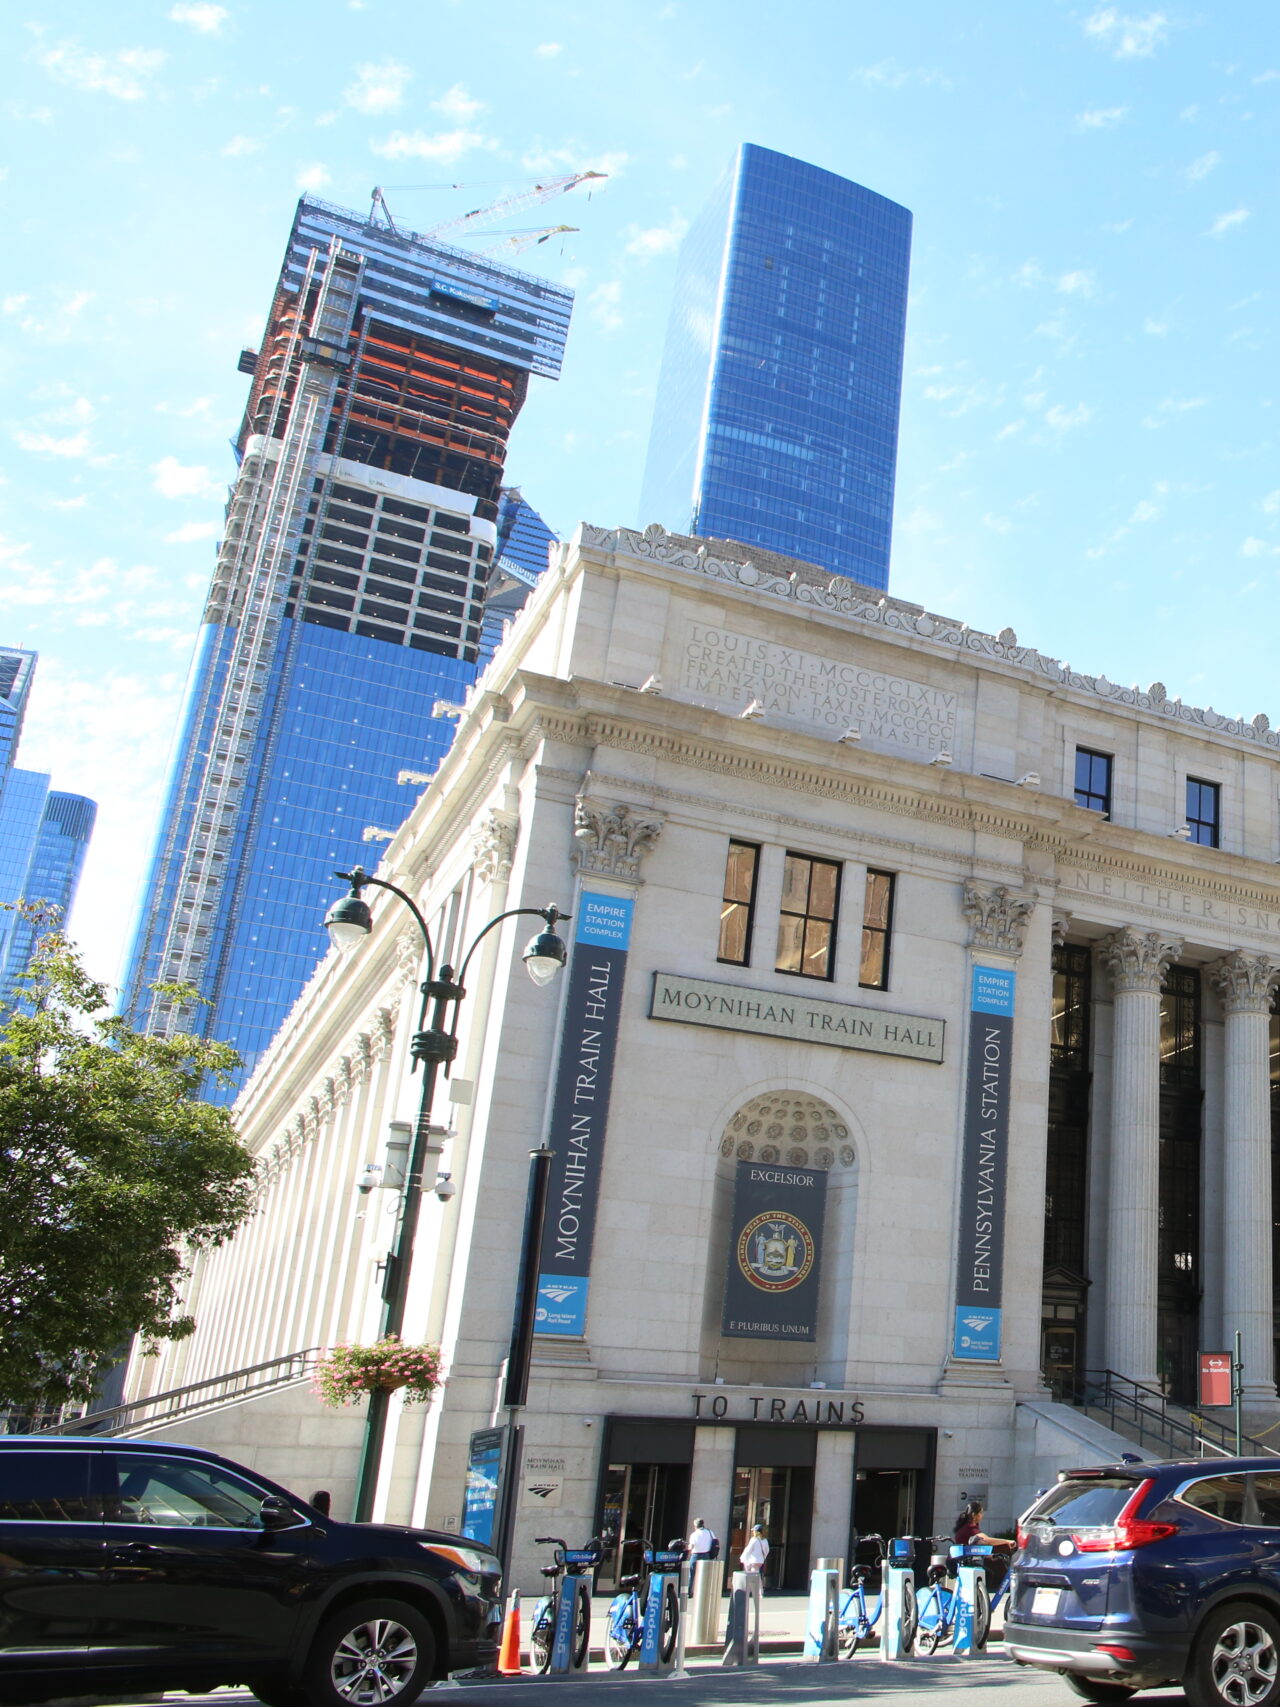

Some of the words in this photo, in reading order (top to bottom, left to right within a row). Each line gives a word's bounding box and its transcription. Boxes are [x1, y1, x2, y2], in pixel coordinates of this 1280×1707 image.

[686, 643, 775, 678] CREATED
[781, 667, 818, 689] THE
[826, 680, 881, 707] POSTE
[888, 696, 955, 726] ROYALE
[691, 626, 767, 660] LOUIS
[780, 651, 803, 670] XI
[819, 661, 955, 708] MCCCCLXIV
[685, 676, 795, 715] IMPERIAL
[812, 708, 949, 752] POSTMASTER
[686, 660, 755, 689] FRANZ
[762, 678, 801, 699] VON
[810, 691, 865, 717] TAXIS
[873, 708, 952, 740] MCCCCC
[585, 915, 625, 928] STATION
[587, 903, 626, 918] EMPIRE
[1074, 871, 1220, 920] NEITHER
[584, 926, 623, 939] COMPLEX
[585, 961, 611, 1021] HALL
[977, 986, 1010, 997] STATION
[977, 996, 1009, 1007] COMPLEX
[978, 975, 1009, 988] EMPIRE
[661, 987, 795, 1025] MOYNIHAN
[806, 1011, 873, 1038] TRAIN
[883, 1024, 936, 1048] HALL
[574, 1028, 603, 1105] TRAIN
[981, 1027, 1001, 1120] STATION
[555, 1114, 592, 1260] MOYNIHAN
[750, 1169, 814, 1187] EXCELSIOR
[973, 1128, 997, 1292] PENNSYLVANIA
[730, 1321, 736, 1330] E
[738, 1321, 780, 1333] PLURIBUS
[782, 1324, 809, 1335] UNUM
[692, 1394, 728, 1418] TO
[749, 1397, 865, 1423] TRAINS
[557, 1597, 572, 1654] gopuff
[645, 1592, 661, 1649] gopuff
